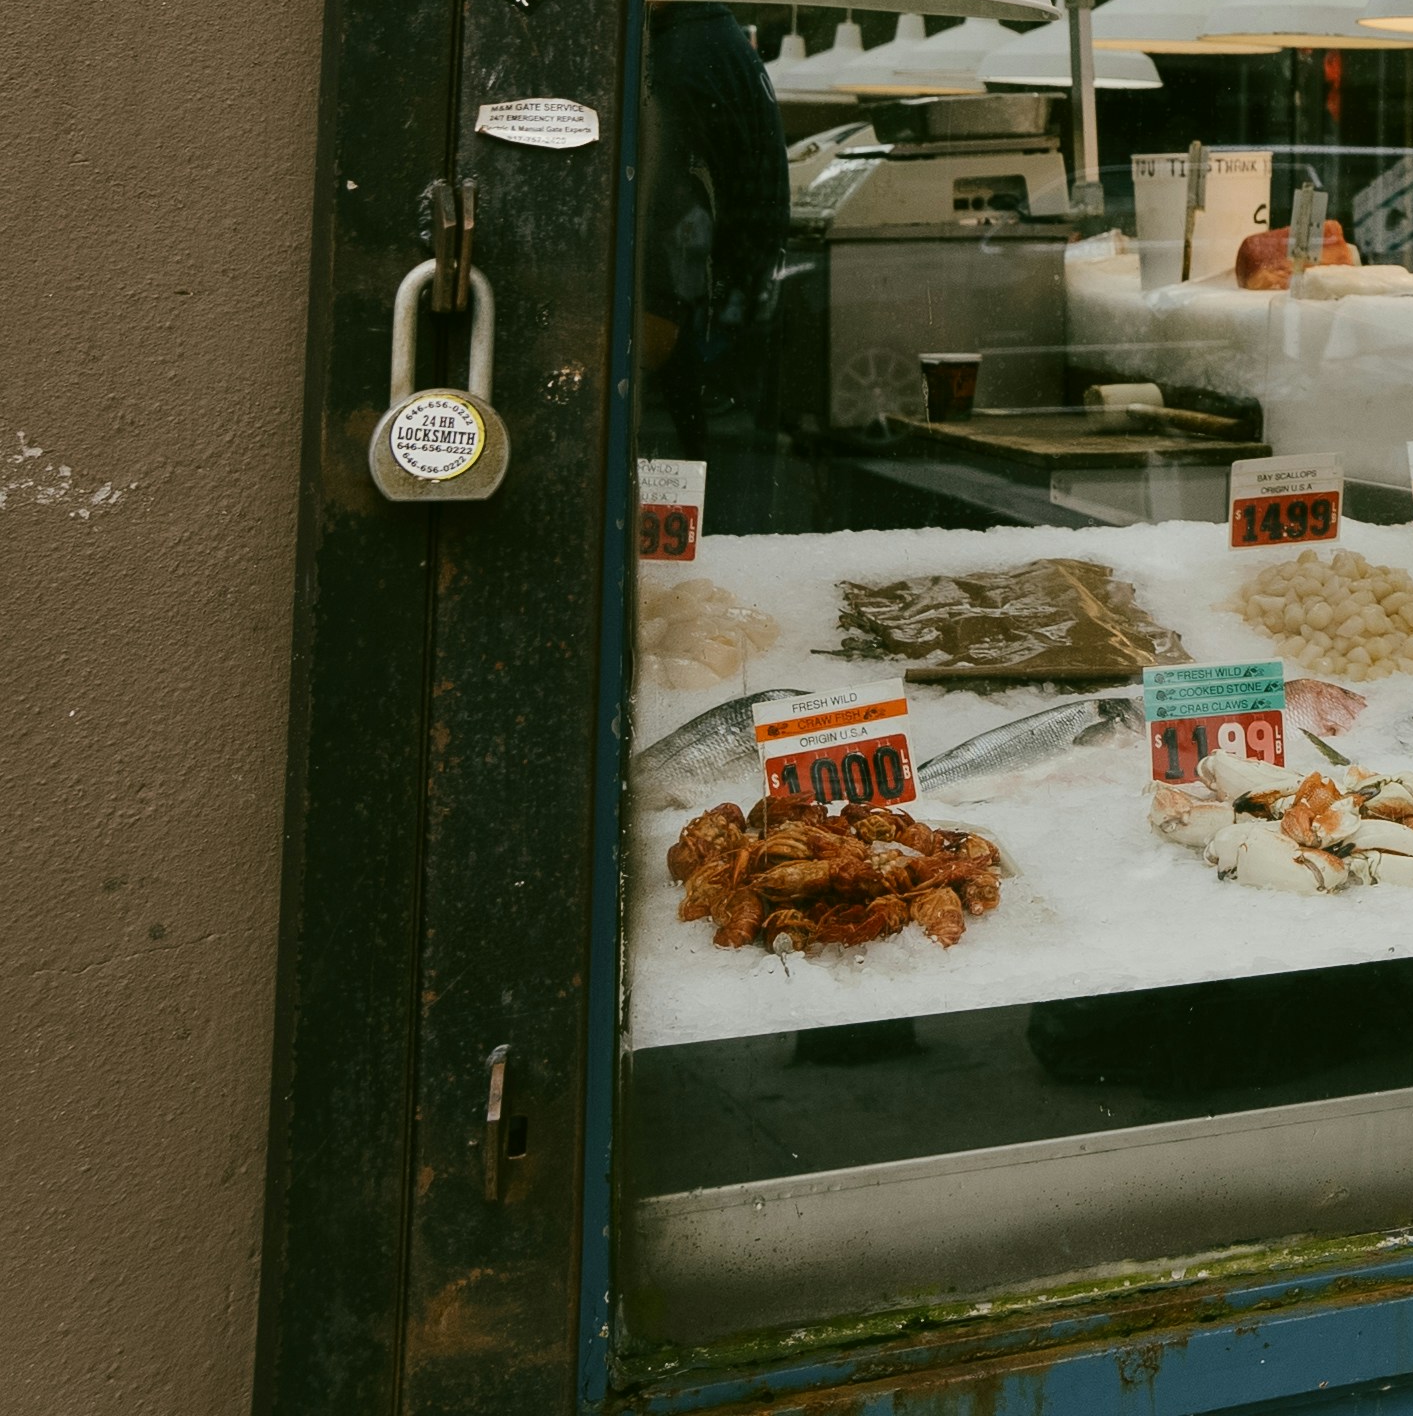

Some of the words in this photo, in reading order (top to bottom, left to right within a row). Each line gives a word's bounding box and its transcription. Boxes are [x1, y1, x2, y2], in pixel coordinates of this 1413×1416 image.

[491, 104, 513, 112] M&M
[515, 103, 540, 111] GATE
[544, 103, 584, 112] SERVICE
[546, 125, 562, 133] Gate
[405, 400, 474, 426] 646-656-0222
[422, 414, 436, 427] 24
[439, 415, 455, 429] HR
[397, 427, 476, 446] LOCKSMITH
[396, 442, 473, 455] 646-656-0222
[402, 452, 467, 474] 646-656-0222
[1257, 473, 1273, 483] BAY
[1274, 470, 1317, 481] SCALLOPS
[1177, 668, 1213, 680] FRESH
[1215, 666, 1242, 677] WILD
[1178, 685, 1225, 698] COOKED
[1226, 682, 1262, 694] STONE
[791, 697, 828, 714] FRESH
[830, 692, 858, 705] WILD
[1179, 702, 1209, 715] CRAB
[1211, 699, 1249, 712] CLAWS
[797, 715, 833, 731] CRAW
[834, 710, 861, 724] FISH
[799, 732, 838, 749] ORIGIN
